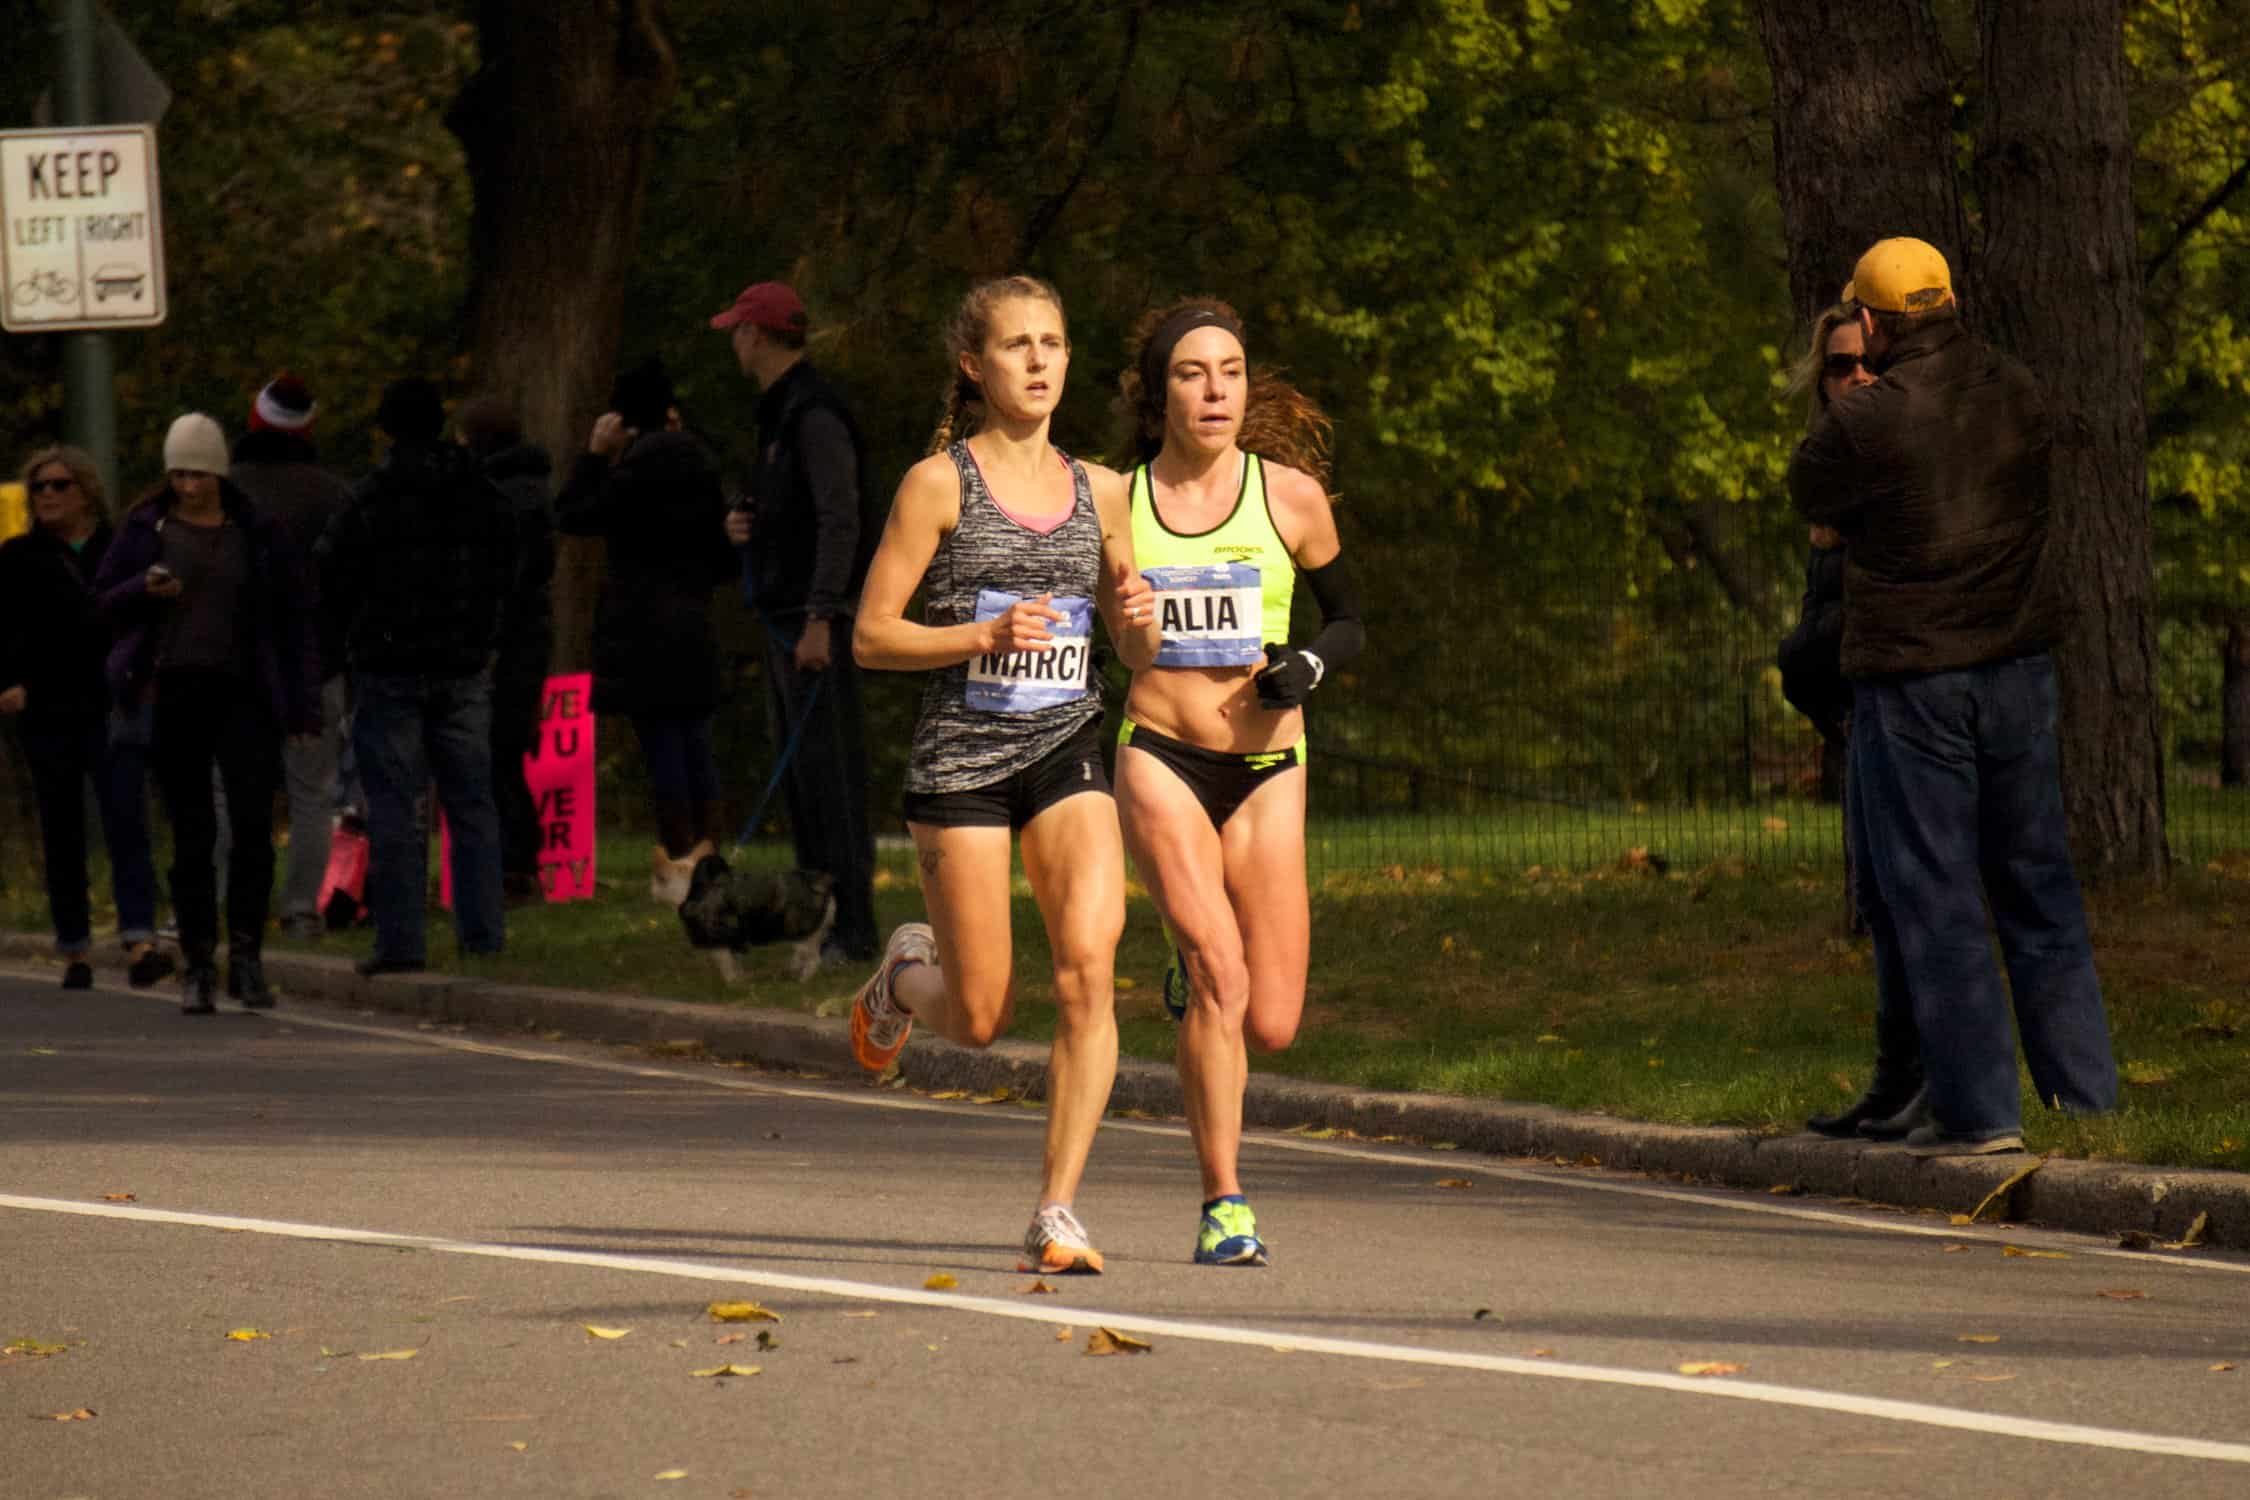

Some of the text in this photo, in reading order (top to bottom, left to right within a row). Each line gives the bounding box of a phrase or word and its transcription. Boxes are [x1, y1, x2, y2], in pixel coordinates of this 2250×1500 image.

[28, 151, 120, 199] KEEP
[15, 216, 65, 246] LEFT
[86, 213, 145, 241] RIGHT
[1161, 595, 1239, 632] ALIA
[979, 645, 1086, 682] MARCI
